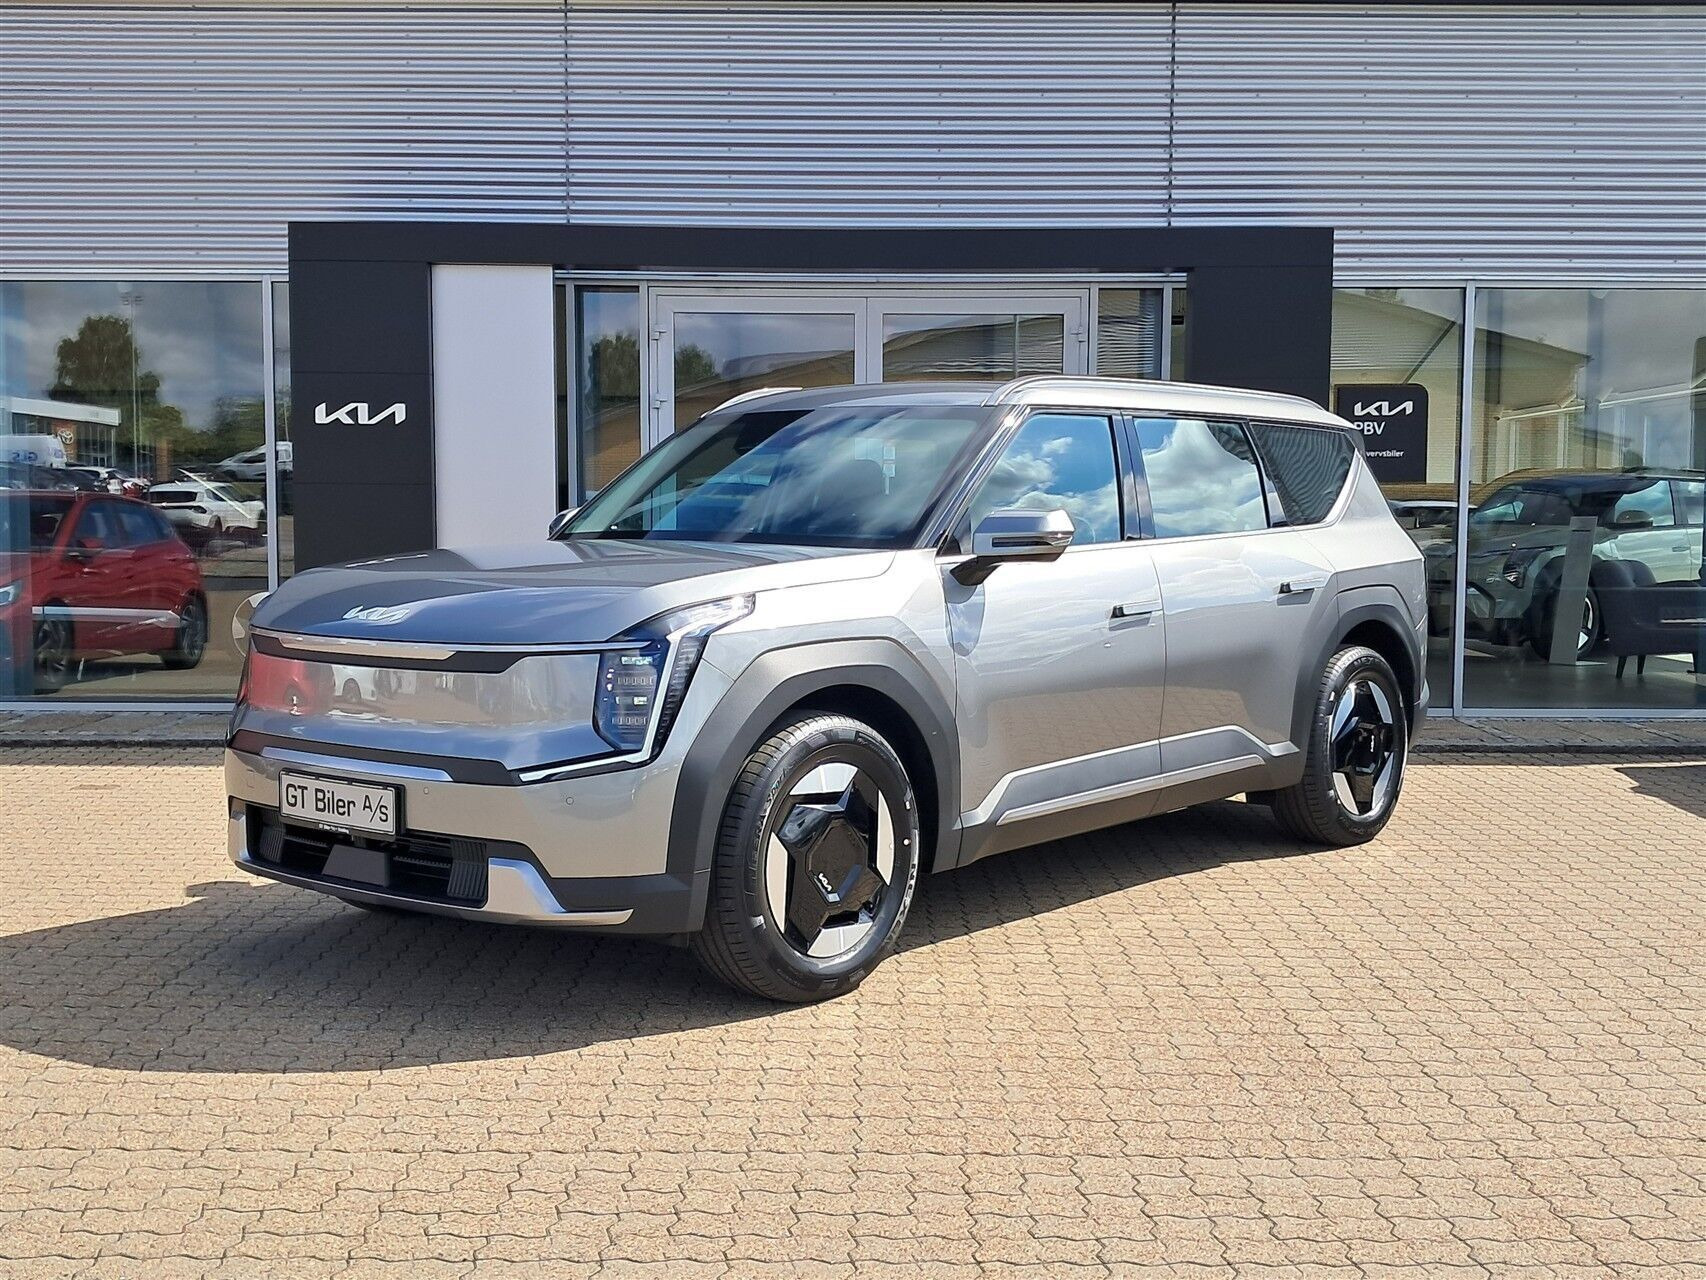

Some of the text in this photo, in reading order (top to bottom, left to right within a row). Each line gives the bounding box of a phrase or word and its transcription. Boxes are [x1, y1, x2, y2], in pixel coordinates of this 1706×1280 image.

[314, 402, 406, 425] KIA
[1353, 401, 1414, 416] KIA
[342, 605, 411, 623] KIA
[285, 783, 389, 823] GT Biler A/S
